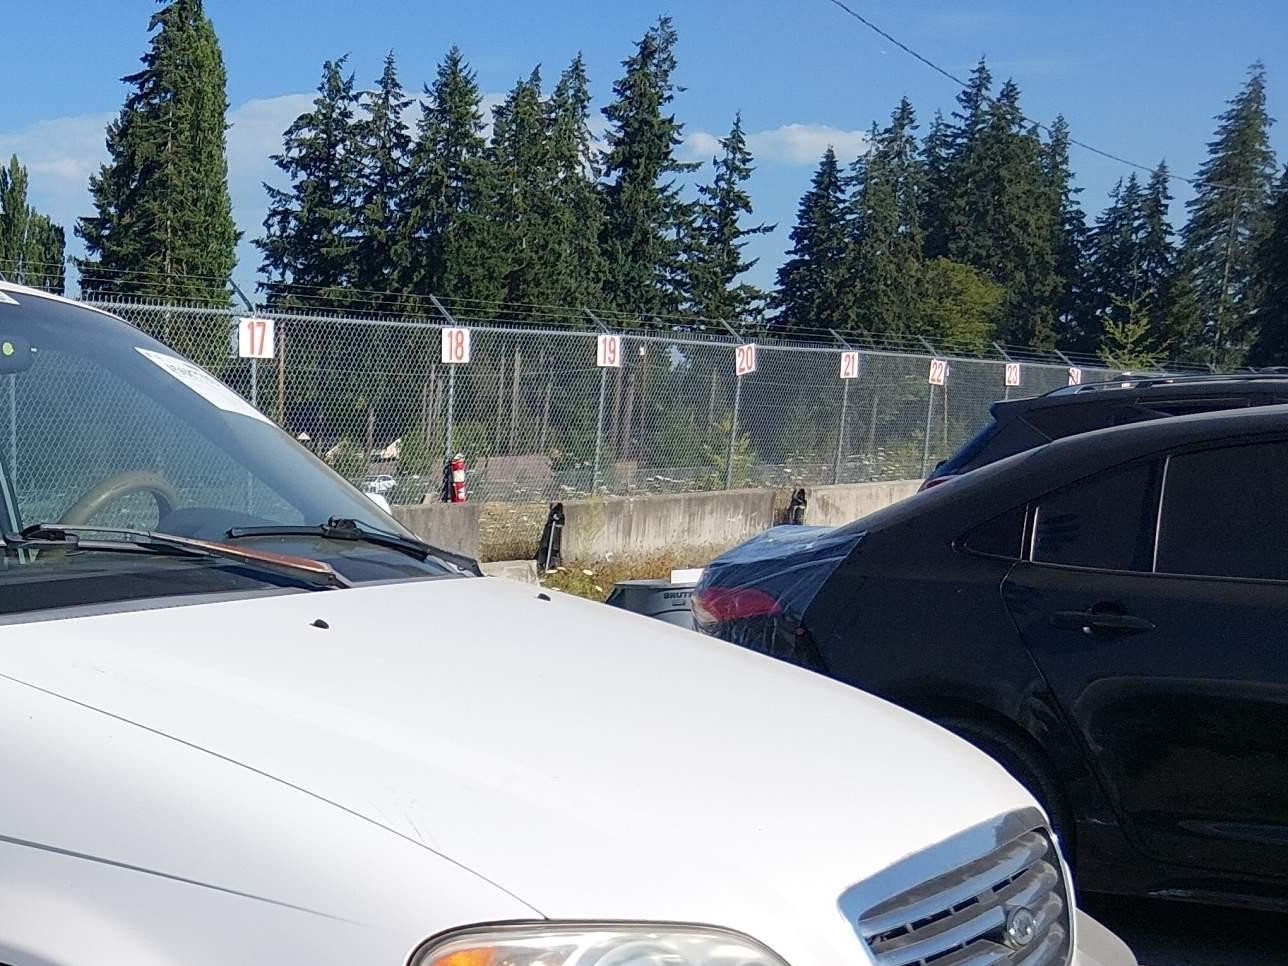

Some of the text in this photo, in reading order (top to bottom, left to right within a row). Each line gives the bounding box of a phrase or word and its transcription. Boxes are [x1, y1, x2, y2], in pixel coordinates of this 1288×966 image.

[247, 321, 266, 355] 17
[447, 330, 464, 361] 18
[602, 336, 616, 365] 19
[738, 345, 753, 373] 20
[844, 353, 856, 377] 21
[930, 361, 944, 383] 22
[1007, 364, 1018, 385] 23
